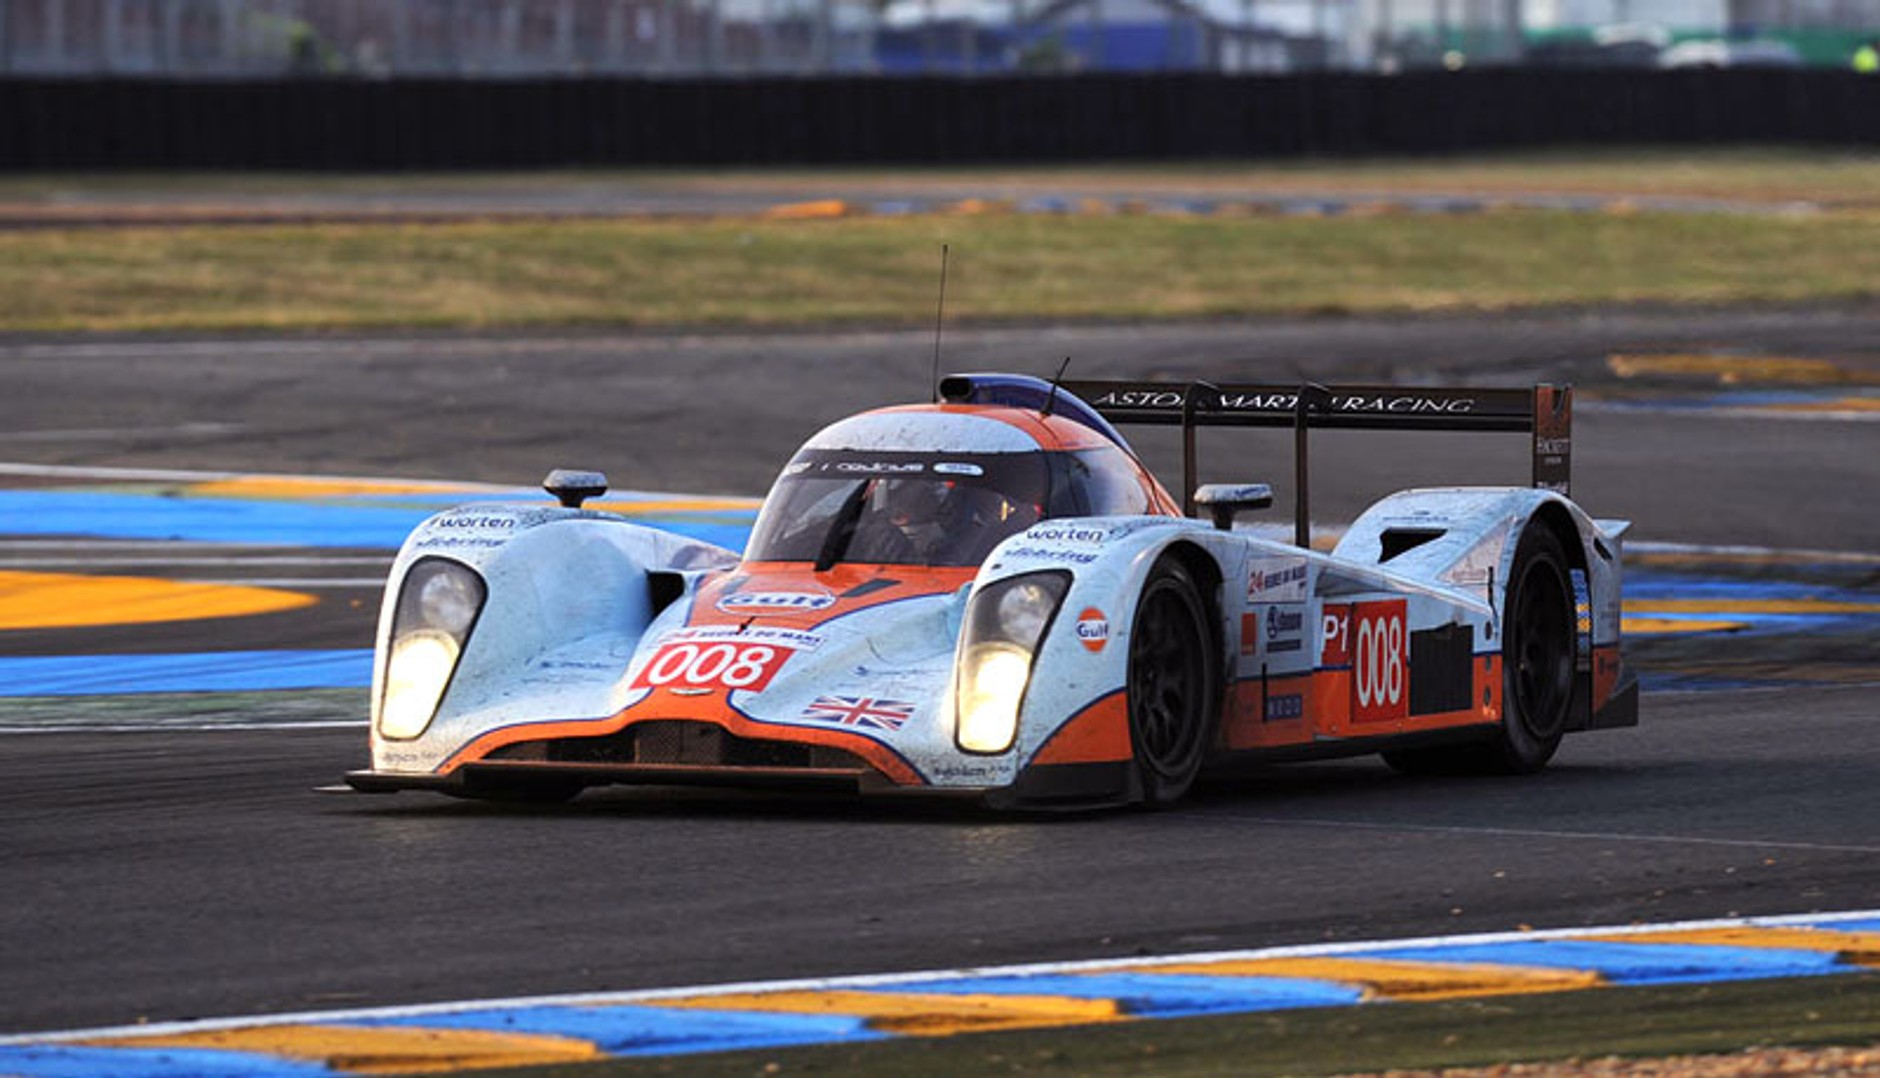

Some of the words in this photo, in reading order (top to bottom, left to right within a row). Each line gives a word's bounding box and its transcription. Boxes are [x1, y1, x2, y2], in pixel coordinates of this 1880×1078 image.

[1341, 396, 1475, 412] RACING
[440, 516, 515, 528] worten
[1027, 529, 1103, 541] worten
[1322, 615, 1349, 653] P1
[648, 643, 775, 687] 008
[1357, 615, 1402, 708] 008
